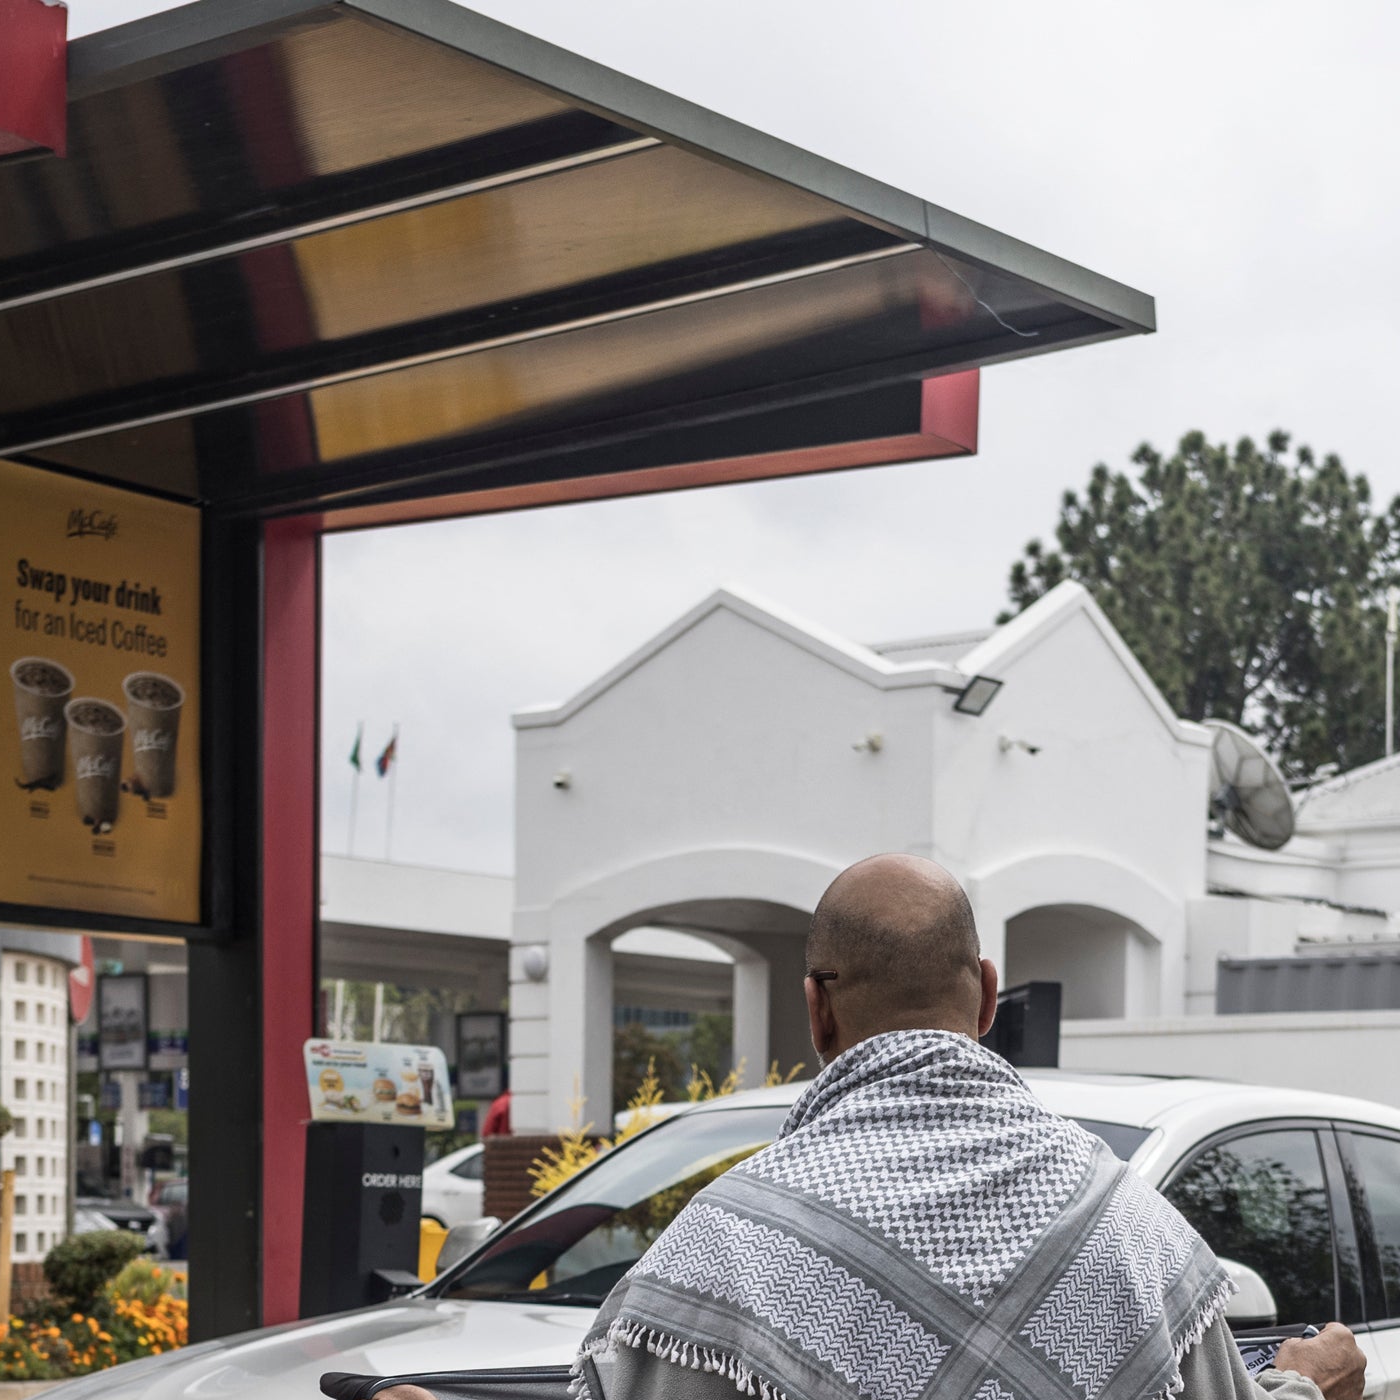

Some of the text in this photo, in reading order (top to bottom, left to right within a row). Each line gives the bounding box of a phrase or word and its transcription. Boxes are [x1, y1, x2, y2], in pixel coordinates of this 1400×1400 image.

[16, 558, 163, 616] Swap your drink
[15, 598, 168, 658] for an Iced Coffee
[362, 1173, 397, 1188] ORDER
